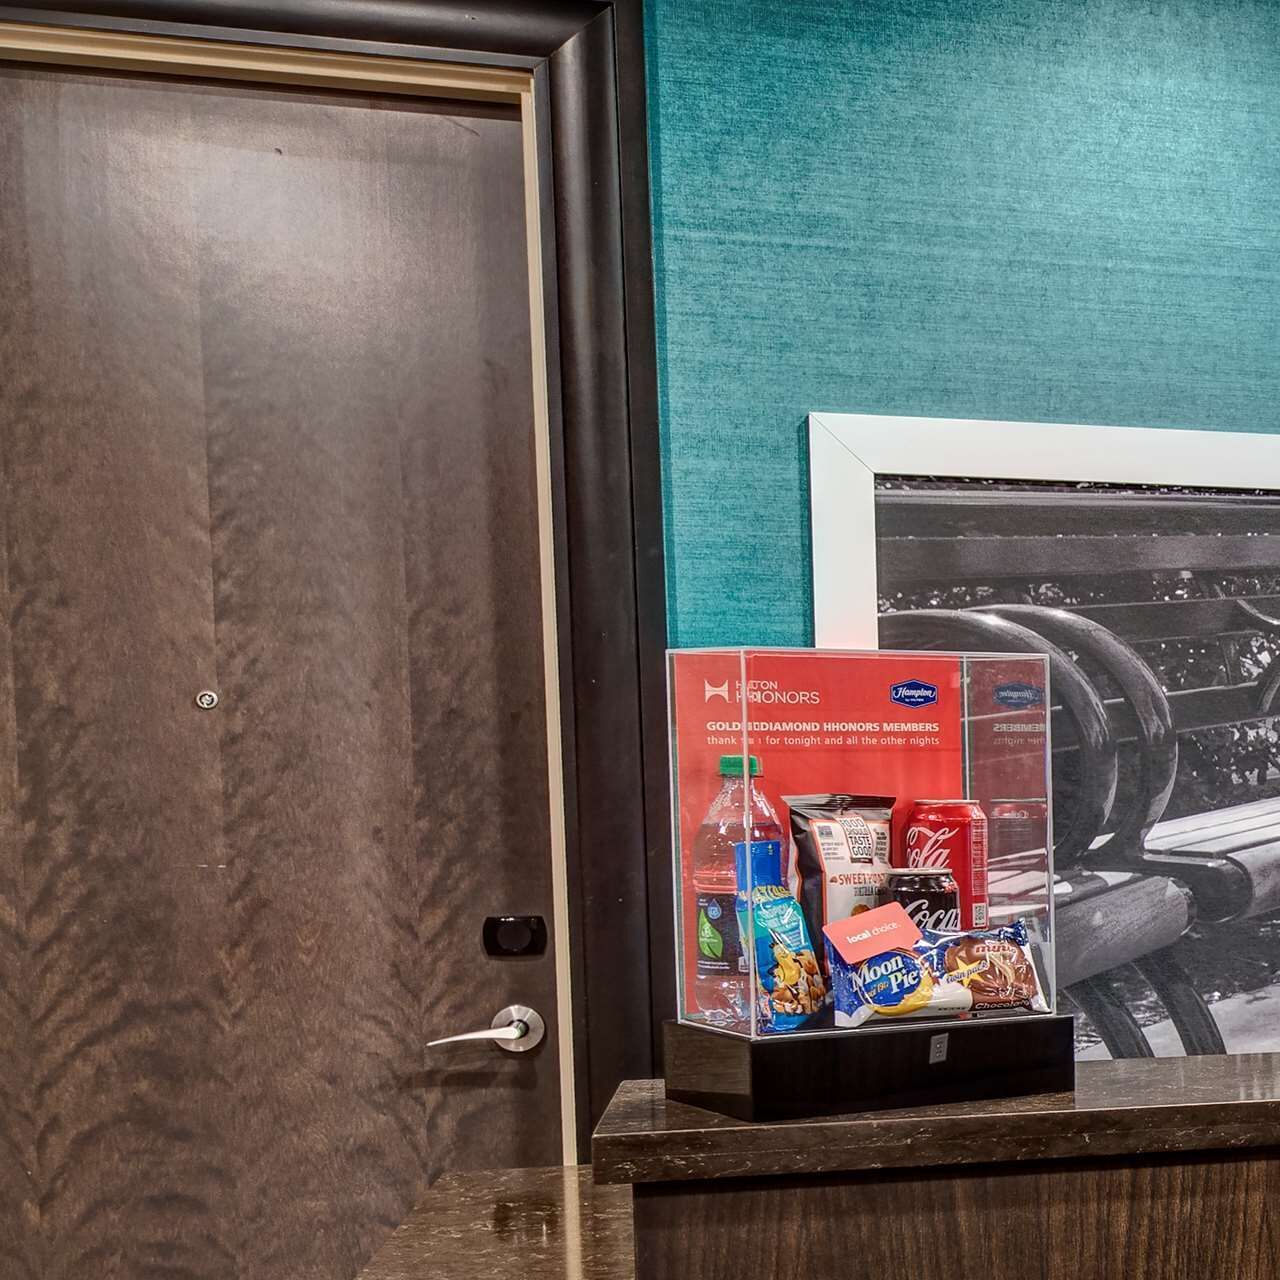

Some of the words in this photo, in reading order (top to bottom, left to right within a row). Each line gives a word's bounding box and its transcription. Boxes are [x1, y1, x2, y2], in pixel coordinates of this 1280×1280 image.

[893, 686, 936, 699] Hampton
[706, 721, 741, 731] GOLD
[823, 722, 880, 732] HHONORS
[883, 722, 940, 732] MEMBERS
[706, 736, 738, 745] thank
[766, 736, 781, 745] for
[784, 736, 821, 747] tonight
[824, 736, 843, 745] and
[846, 736, 858, 745] all
[861, 736, 878, 745] the
[880, 736, 907, 745] other
[910, 736, 940, 747] nights
[848, 835, 871, 846] TASTE
[851, 846, 872, 856] GOOD
[838, 872, 866, 886] SWEET
[846, 930, 872, 944] local
[851, 955, 904, 992] Moon
[888, 968, 919, 994] Pie
